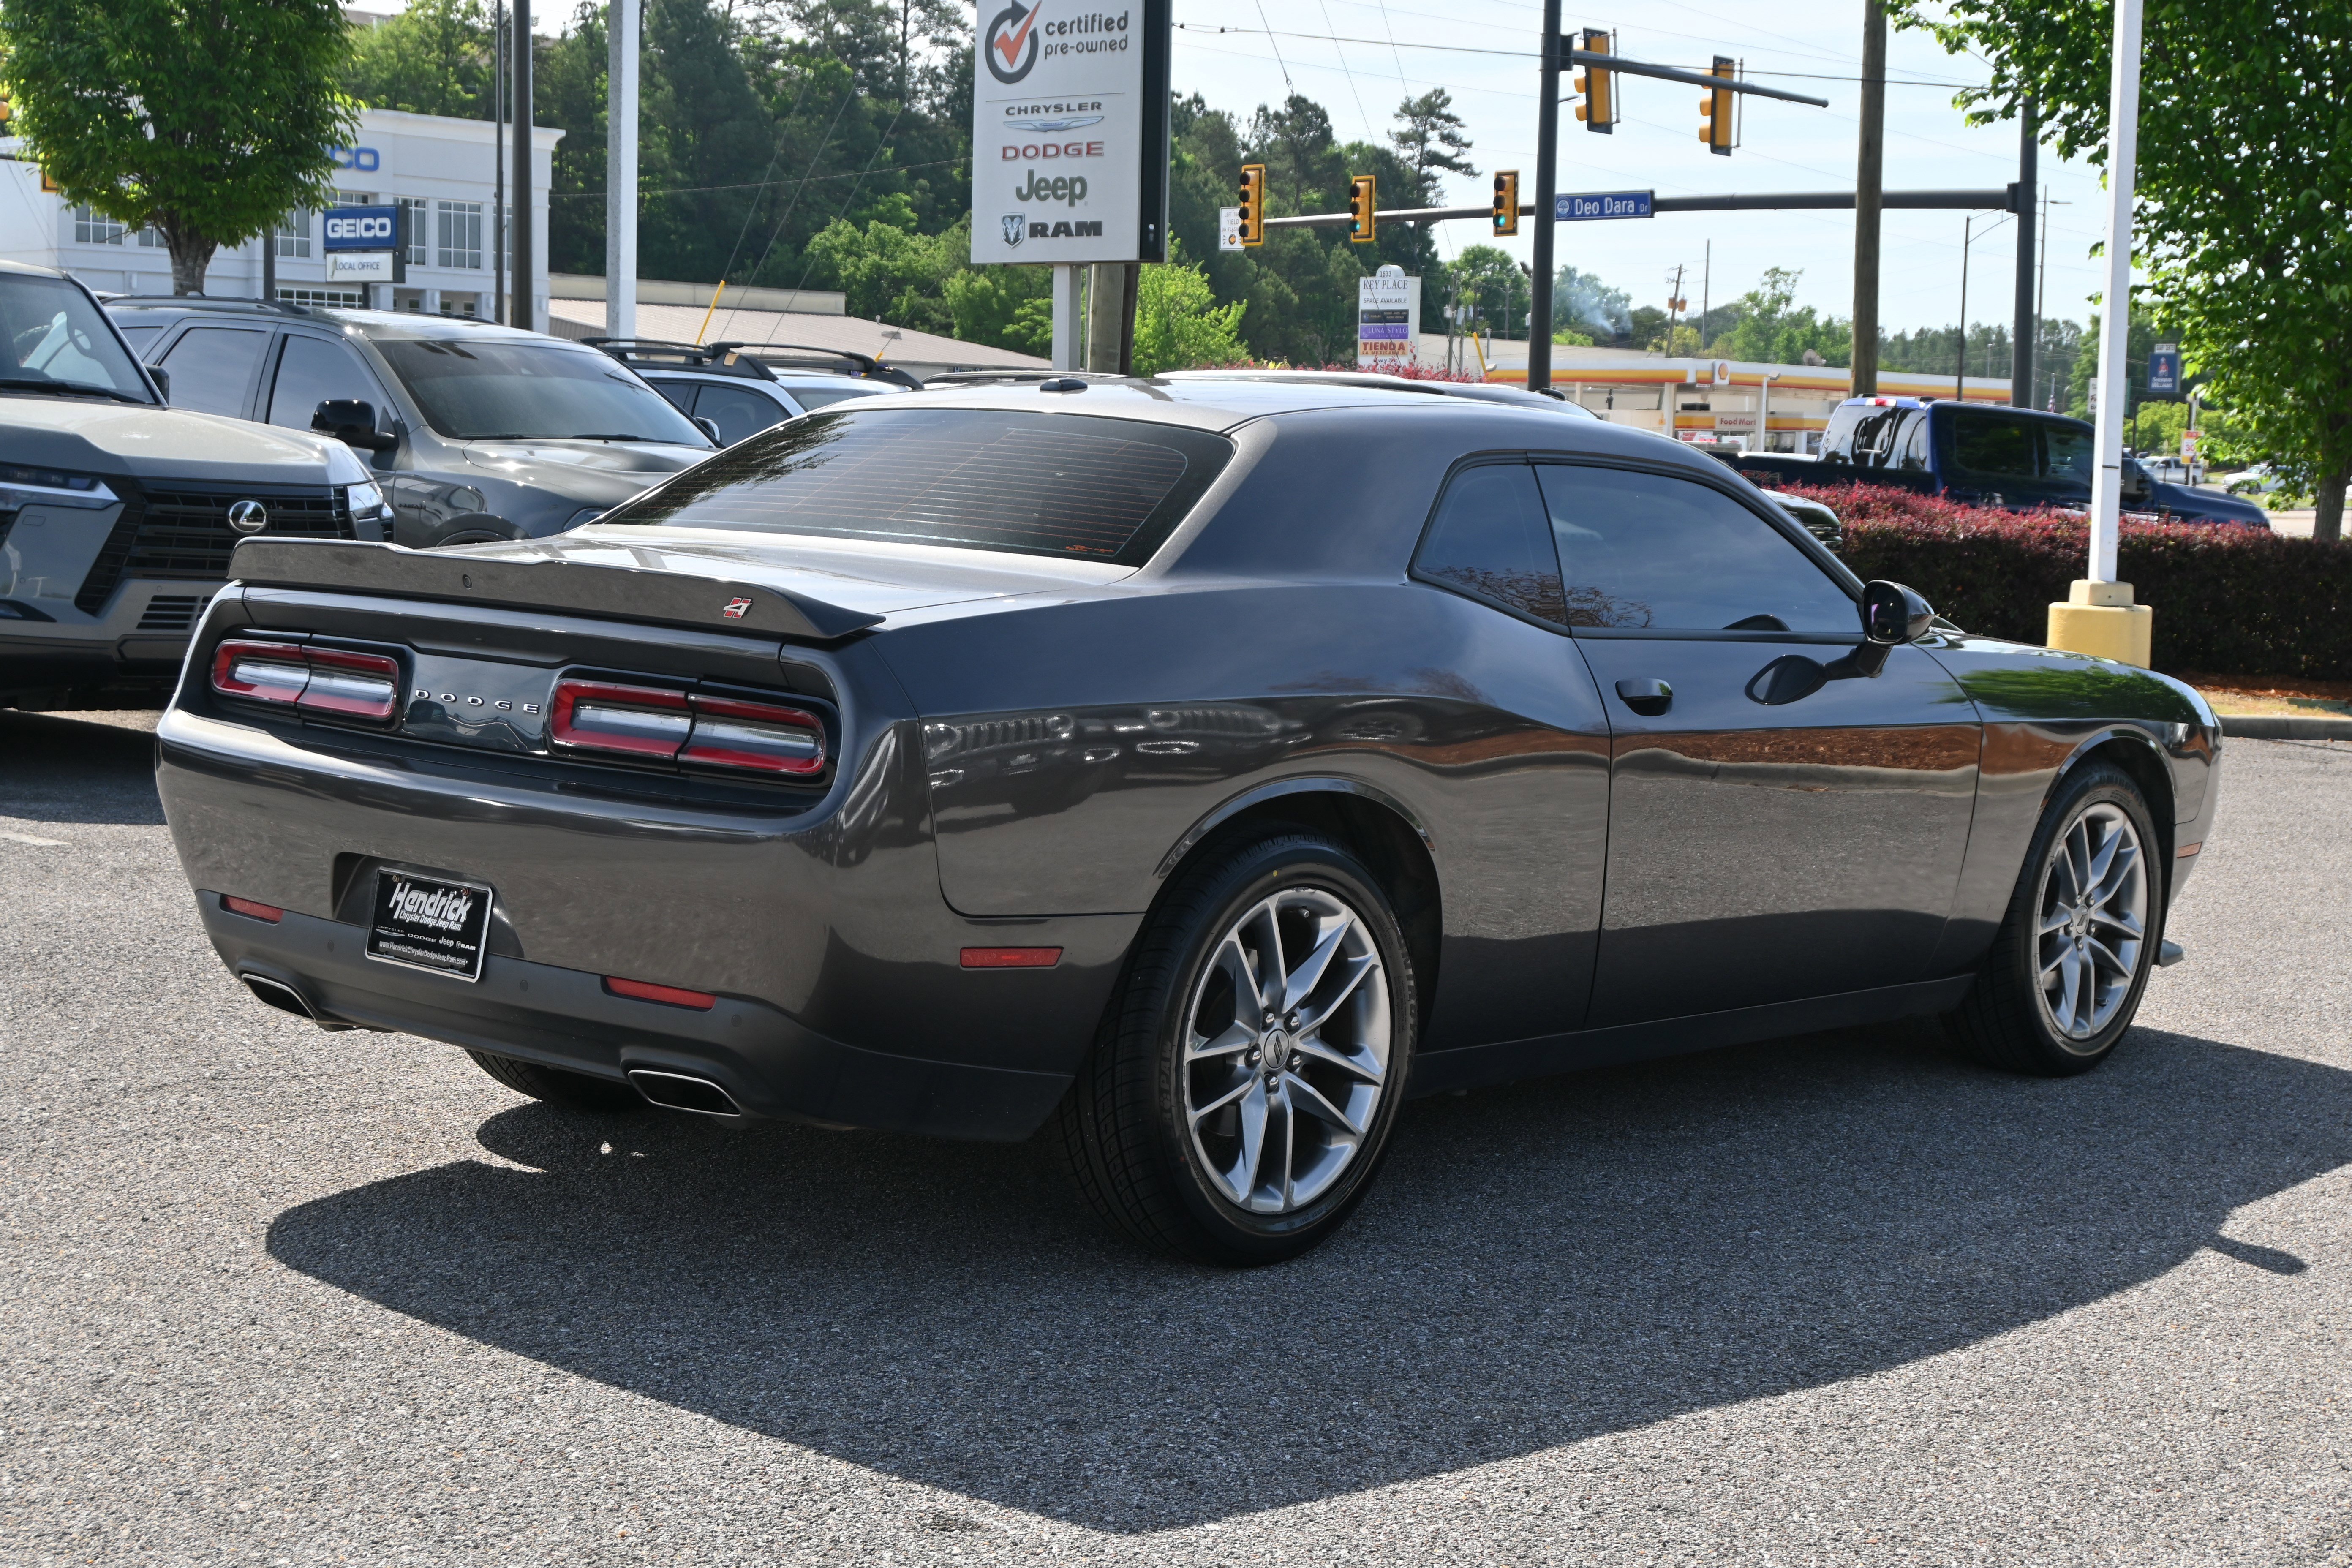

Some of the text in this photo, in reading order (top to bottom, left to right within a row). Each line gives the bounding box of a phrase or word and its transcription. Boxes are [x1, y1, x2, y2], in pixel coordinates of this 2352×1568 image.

[1045, 10, 1129, 35] certified
[1045, 34, 1128, 59] pre-owned
[1005, 101, 1102, 115] CHRYSLER
[1002, 141, 1104, 161] DODGE
[1016, 169, 1088, 207] Jeep
[1575, 197, 1648, 215] Deo Dara Dr
[327, 217, 391, 238] GEICO
[1029, 220, 1103, 237] RAM
[336, 261, 380, 270] LOCAL OFFICE
[1363, 279, 1408, 289] KEY PLACE
[1362, 342, 1405, 351] TIENDA
[1741, 470, 1783, 483] FX4
[415, 689, 540, 713] DODGE
[389, 882, 473, 923] Hendrick
[399, 909, 463, 931] Chrysler Dodge Jeep Ram
[377, 925, 404, 933] CHRYSLER
[407, 933, 437, 943] DODGE
[438, 936, 454, 947] Jeep
[379, 940, 466, 966] www.HendrickChryslerDodgeJeepRam.com
